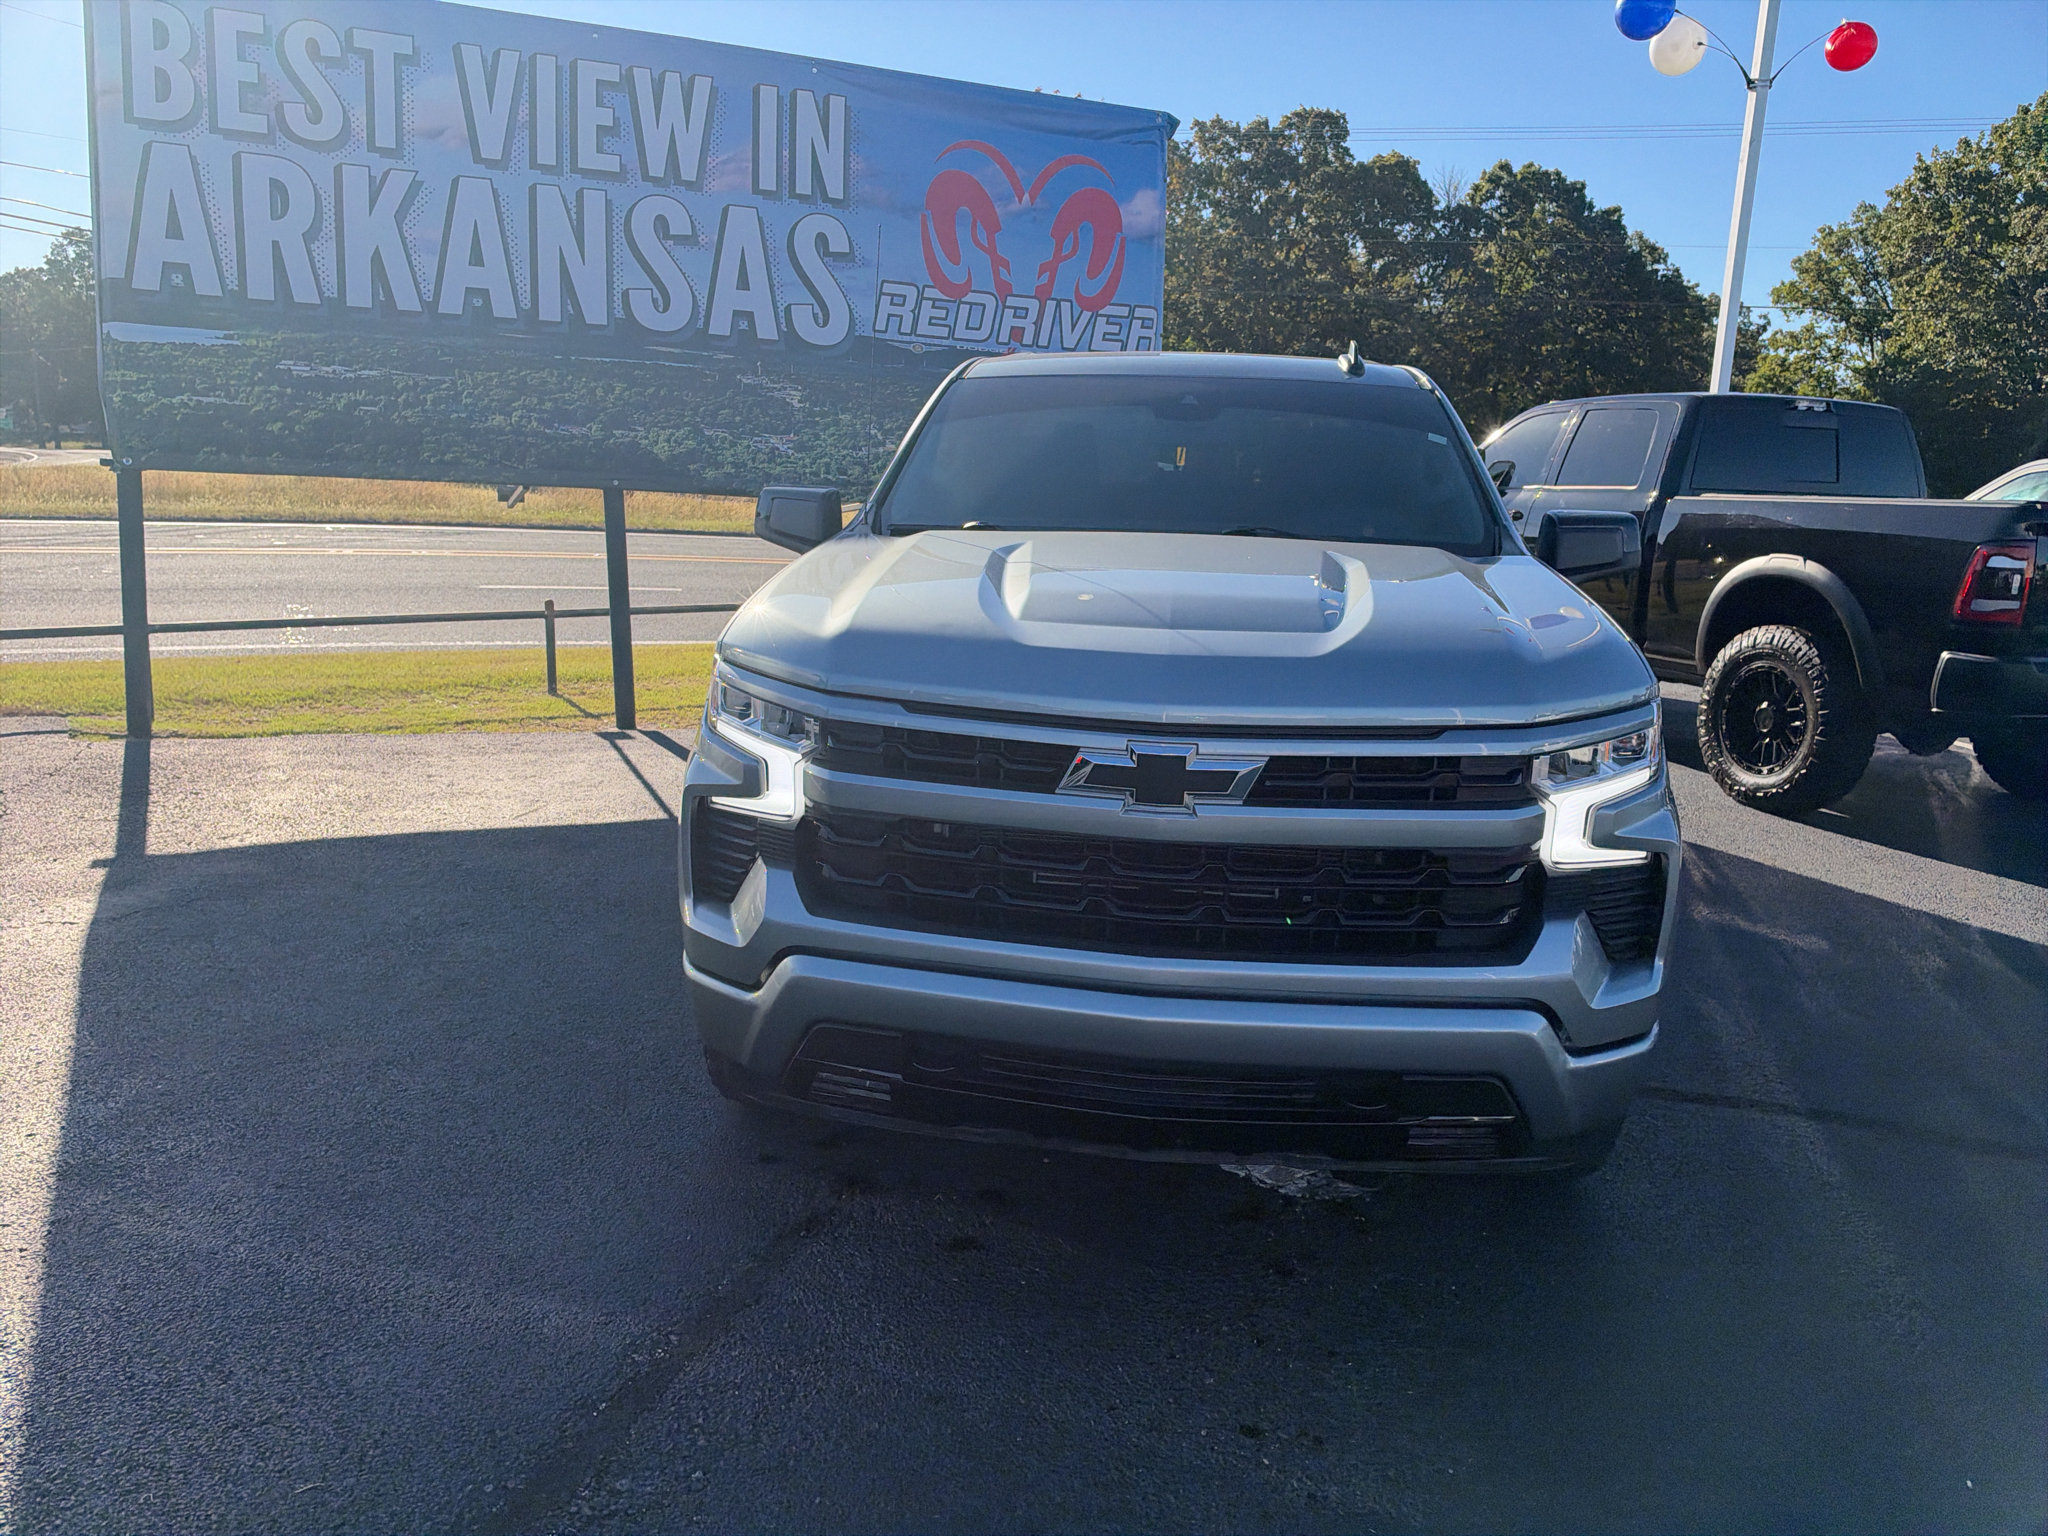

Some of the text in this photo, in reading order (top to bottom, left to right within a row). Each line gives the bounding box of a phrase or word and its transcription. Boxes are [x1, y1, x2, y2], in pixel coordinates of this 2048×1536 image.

[121, 0, 848, 200] BEST VIEW IN
[130, 140, 853, 347] ARKANSAS
